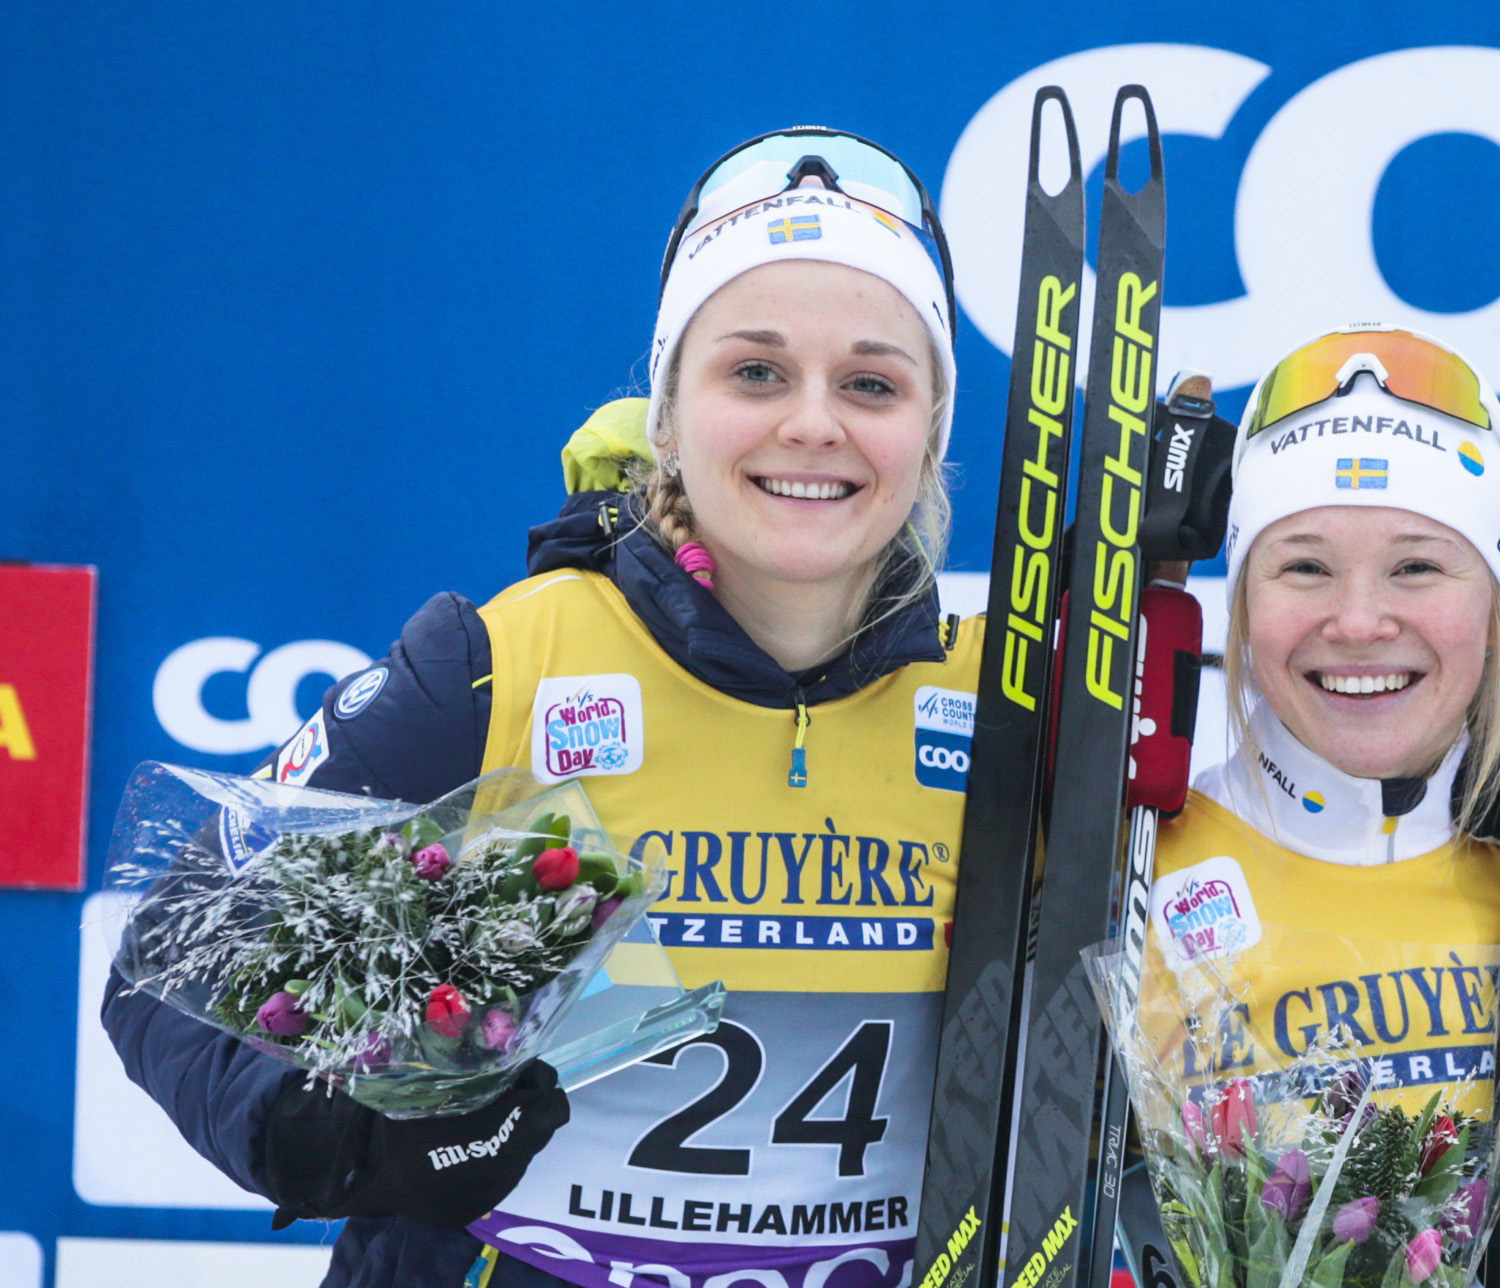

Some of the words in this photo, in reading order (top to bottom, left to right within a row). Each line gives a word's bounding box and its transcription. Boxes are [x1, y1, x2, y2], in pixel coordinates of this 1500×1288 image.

[688, 195, 863, 259] VATTENFALL
[1271, 415, 1447, 454] VATTENFALL
[1001, 274, 1076, 712] FISCHER
[1086, 271, 1157, 711] FISCHER
[941, 697, 973, 711] CROSS
[942, 708, 975, 721] COUNT
[918, 744, 971, 773] coo
[628, 817, 935, 906] GRUYÈRE
[646, 917, 918, 946] TZERLAND
[628, 1018, 892, 1178] 24
[568, 1184, 908, 1236] LILLEHAMMER
[947, 1205, 982, 1262] MAX
[1042, 1205, 1078, 1263] MAX
